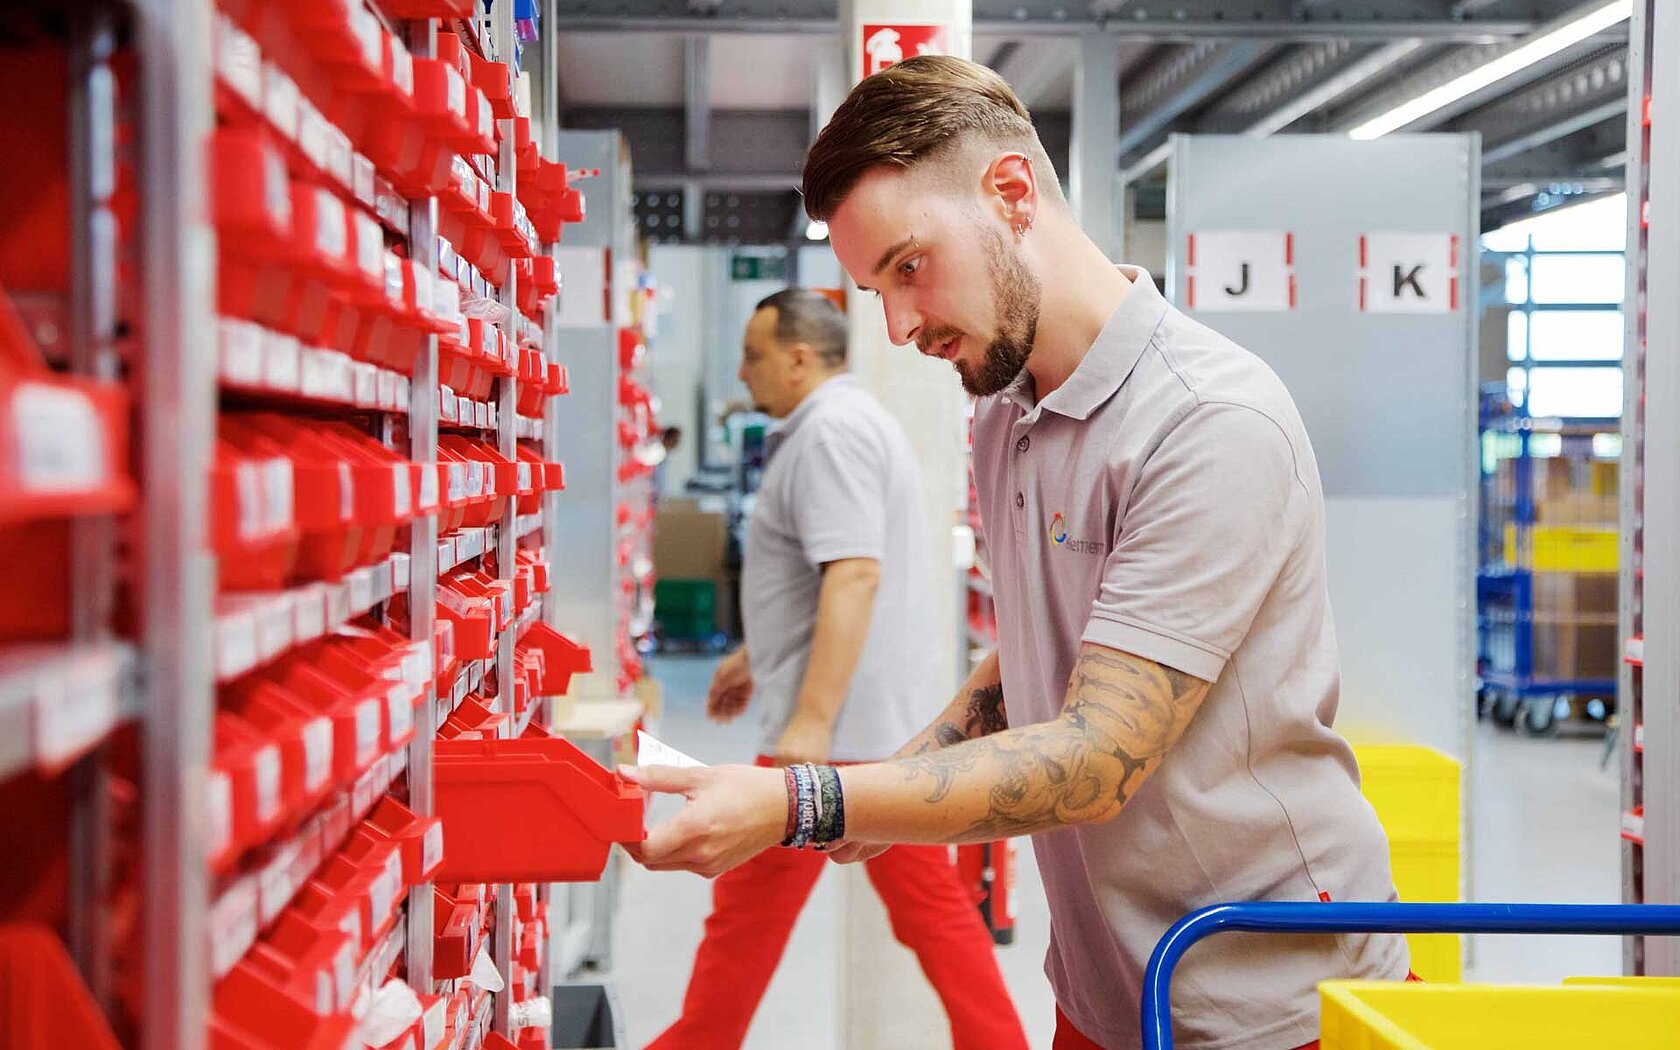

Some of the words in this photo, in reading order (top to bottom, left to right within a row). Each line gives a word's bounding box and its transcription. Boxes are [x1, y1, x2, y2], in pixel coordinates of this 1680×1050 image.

[1225, 263, 1249, 296] J
[1393, 265, 1425, 297] K
[802, 795, 814, 830] FORCE
